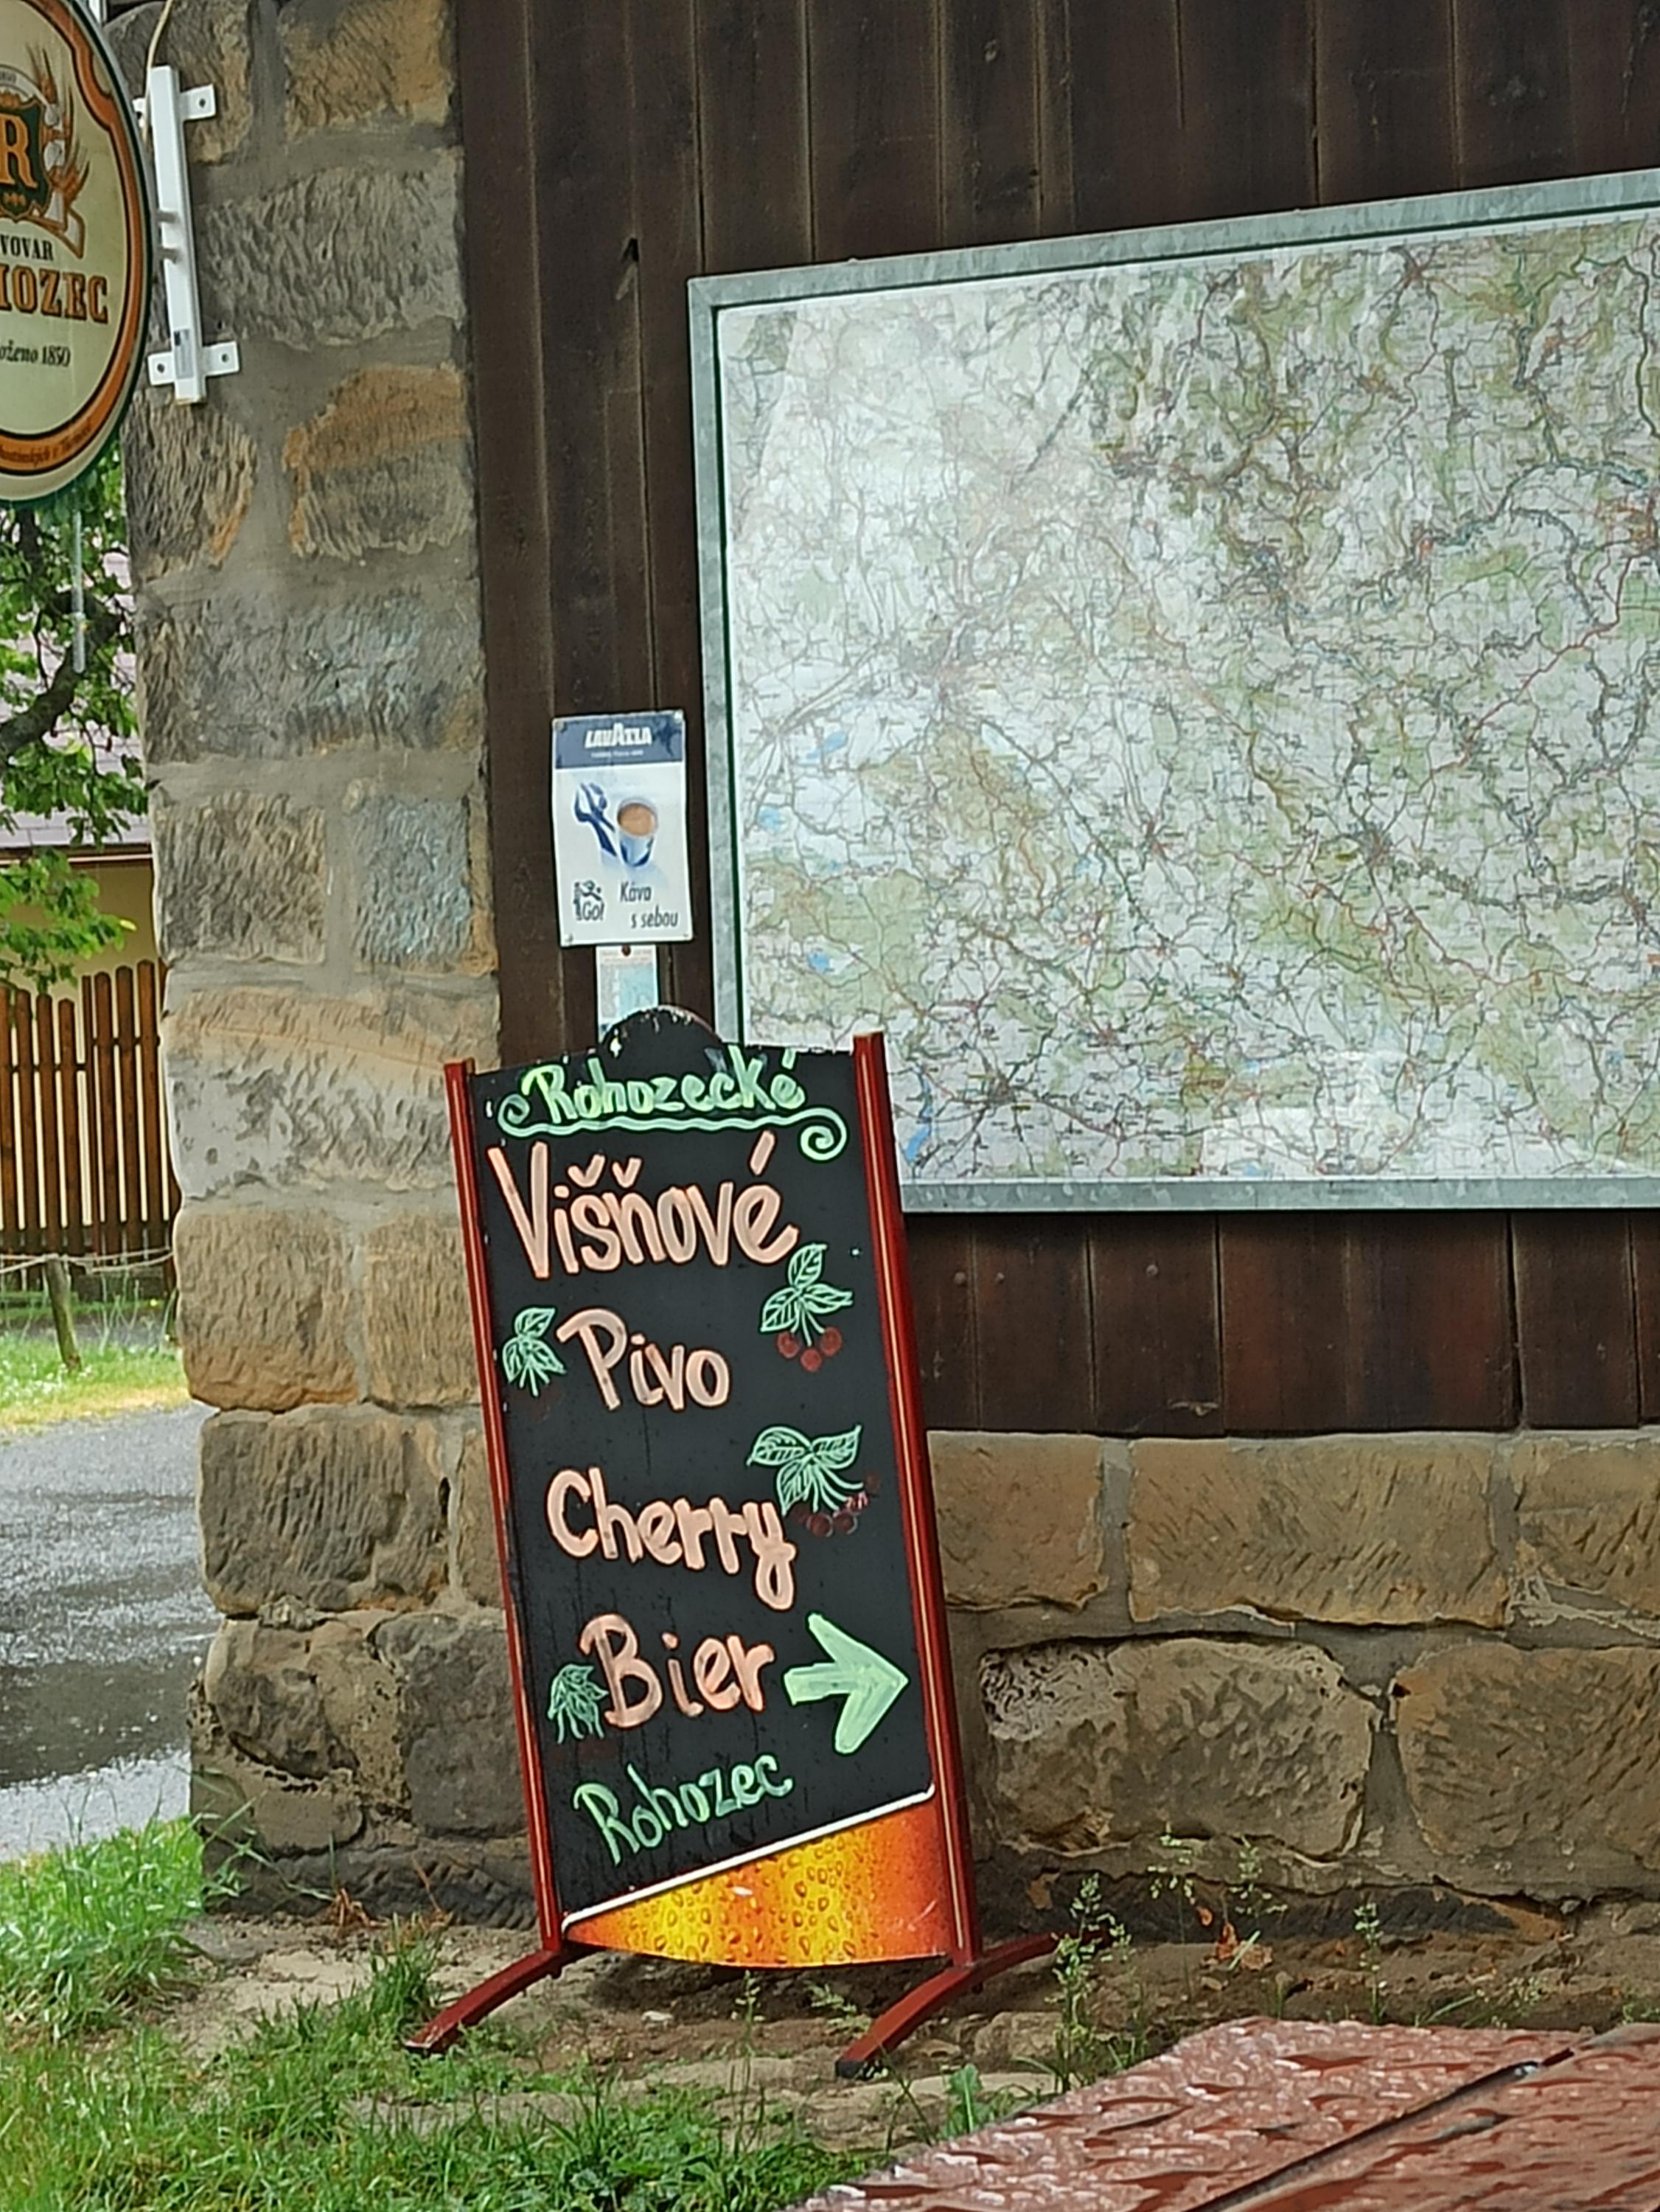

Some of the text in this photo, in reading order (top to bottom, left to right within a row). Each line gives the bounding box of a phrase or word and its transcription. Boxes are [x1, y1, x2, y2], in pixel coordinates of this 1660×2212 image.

[585, 722, 652, 748] LAVAZZA
[641, 904, 678, 928] sebou
[521, 1044, 807, 1124] Rohozecké
[487, 1130, 799, 1279] Višňové
[556, 1308, 730, 1411] Pivo
[546, 1467, 797, 1610] Cherry
[579, 1613, 775, 1728] Bier
[573, 1754, 794, 1865] Rohozec
